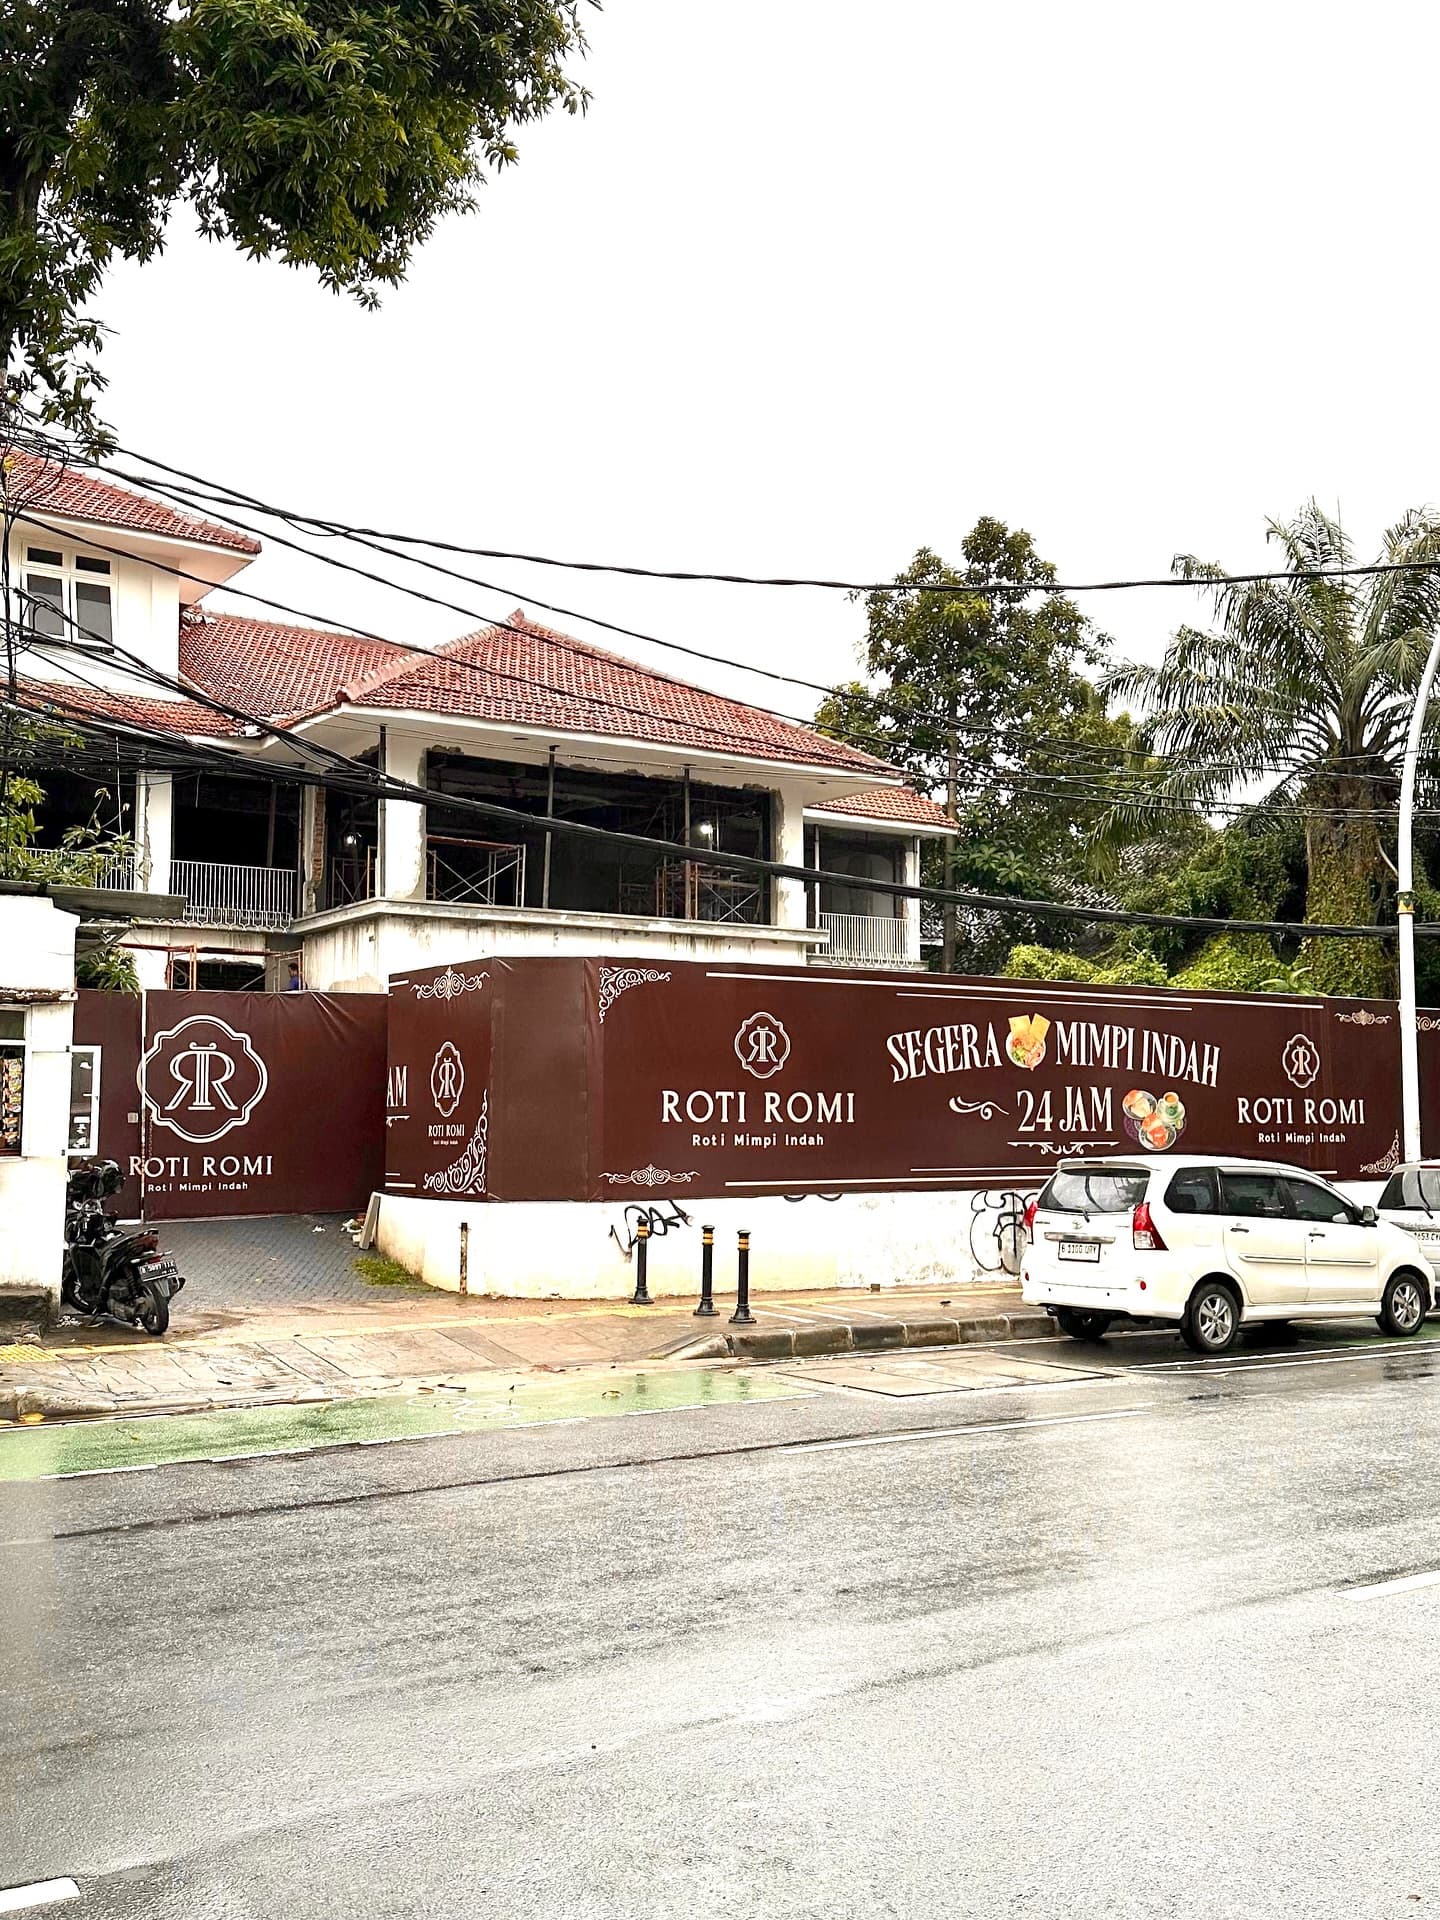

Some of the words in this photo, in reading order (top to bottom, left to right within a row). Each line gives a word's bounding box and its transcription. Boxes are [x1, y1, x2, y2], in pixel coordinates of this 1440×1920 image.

[886, 1021, 1003, 1083] SEGERA
[1055, 1021, 1135, 1068] MIMPI
[1140, 1029, 1221, 1088] INDAH
[661, 1090, 746, 1123] ROTI
[764, 1091, 855, 1123] ROMI
[1016, 1090, 1054, 1132] 24
[1059, 1087, 1113, 1132] JAM
[1237, 1097, 1294, 1124] ROTI
[1304, 1098, 1365, 1125] ROMI
[428, 1124, 444, 1137] ROTI
[446, 1124, 465, 1137] ROMI
[692, 1133, 725, 1147] Roti
[734, 1133, 777, 1149] Mimpi
[785, 1133, 824, 1147] Indah
[1258, 1132, 1280, 1143] Roti
[1285, 1132, 1314, 1145] Mimpi
[1319, 1132, 1346, 1143] Indah
[129, 1155, 189, 1178] ROTI
[202, 1155, 273, 1177] ROMI
[147, 1182, 172, 1192] Roti
[179, 1182, 212, 1193] Mimpi
[218, 1181, 248, 1191] Indah
